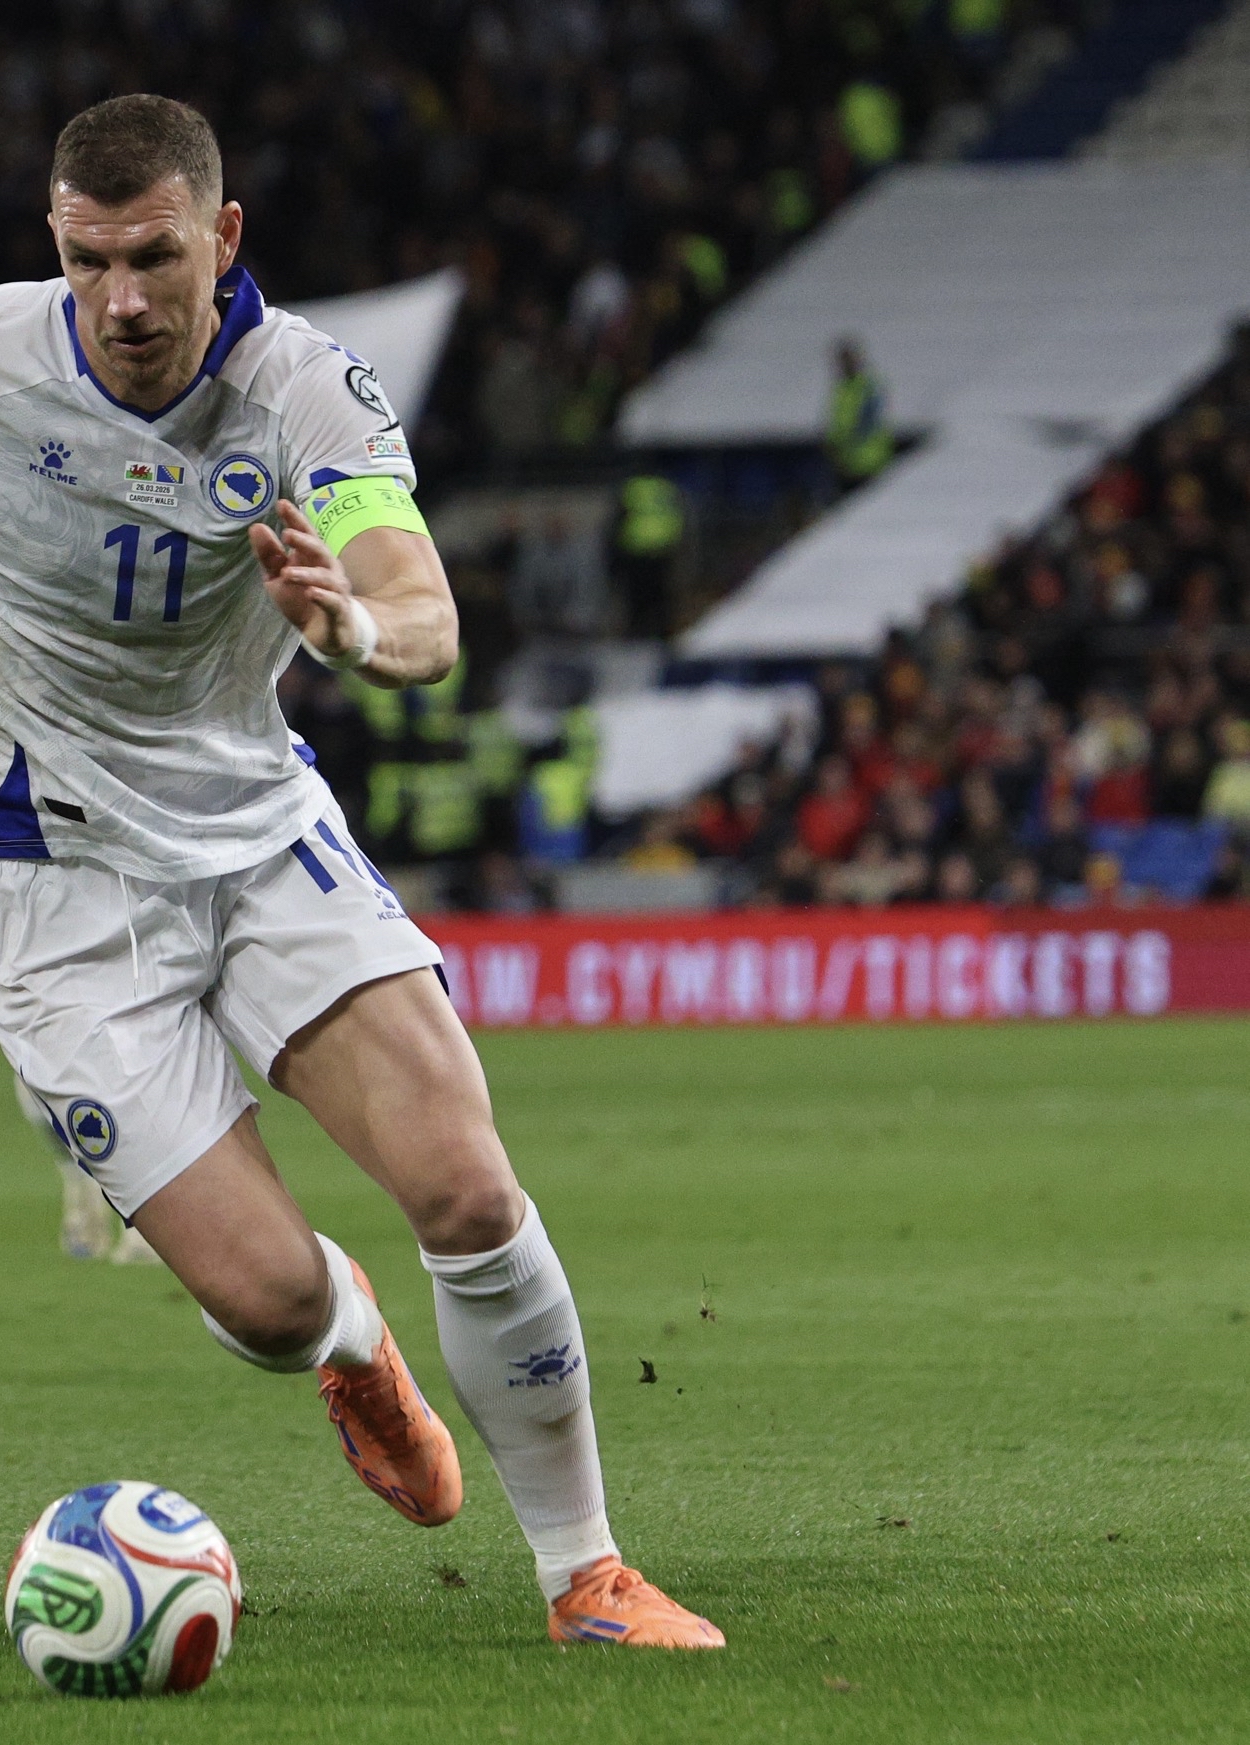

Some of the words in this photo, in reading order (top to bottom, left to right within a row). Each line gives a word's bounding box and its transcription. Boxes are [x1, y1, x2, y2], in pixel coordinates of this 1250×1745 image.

[367, 443, 408, 455] FOUN
[29, 463, 78, 486] KELME
[155, 497, 175, 506] WALES
[103, 523, 189, 622] 11
